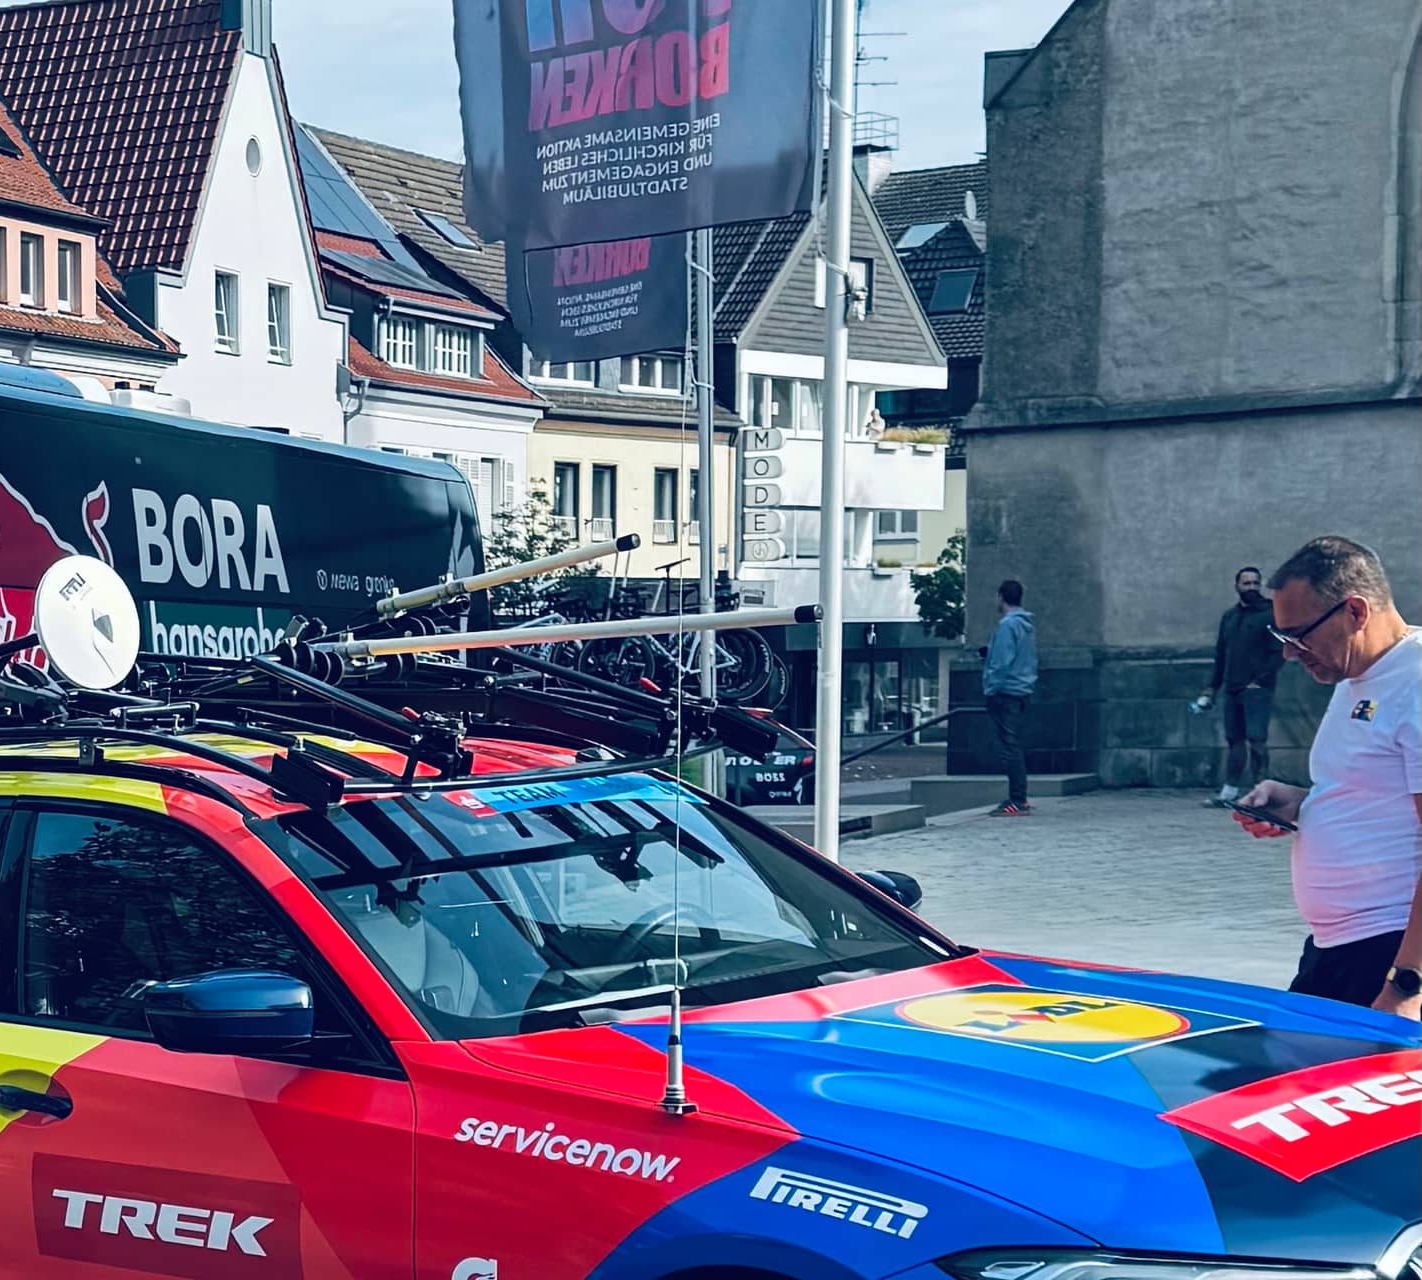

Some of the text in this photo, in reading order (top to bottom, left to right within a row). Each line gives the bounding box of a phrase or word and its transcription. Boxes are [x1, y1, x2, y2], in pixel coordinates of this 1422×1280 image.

[754, 431, 770, 531] MODE
[132, 488, 290, 593] BORA
[491, 782, 564, 801] TEAM
[957, 999, 1122, 1033] LIDL
[453, 1116, 681, 1183] servicenow
[52, 1188, 275, 1257] TREK
[749, 1165, 929, 1240] PIRELLI
